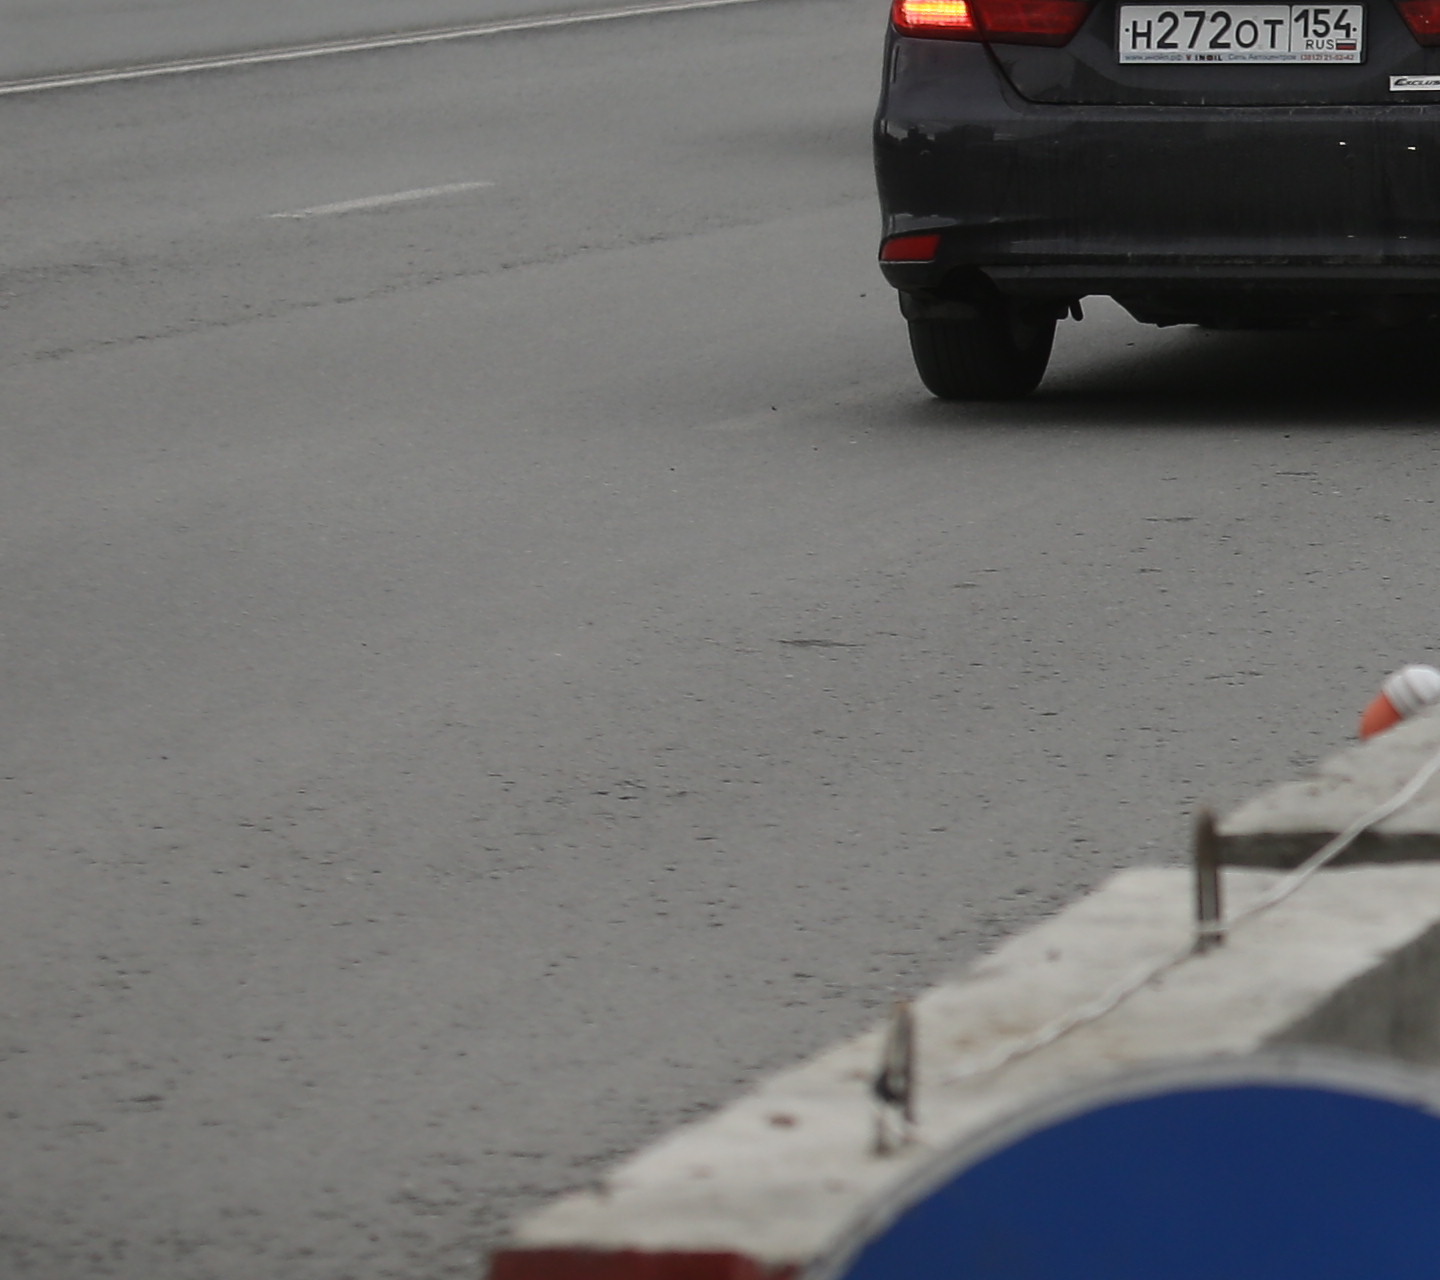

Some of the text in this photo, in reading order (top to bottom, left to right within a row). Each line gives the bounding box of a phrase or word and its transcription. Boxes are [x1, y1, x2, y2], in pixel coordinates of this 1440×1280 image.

[1131, 9, 1352, 49] Н272ОТ 154
[1306, 39, 1334, 50] RUS
